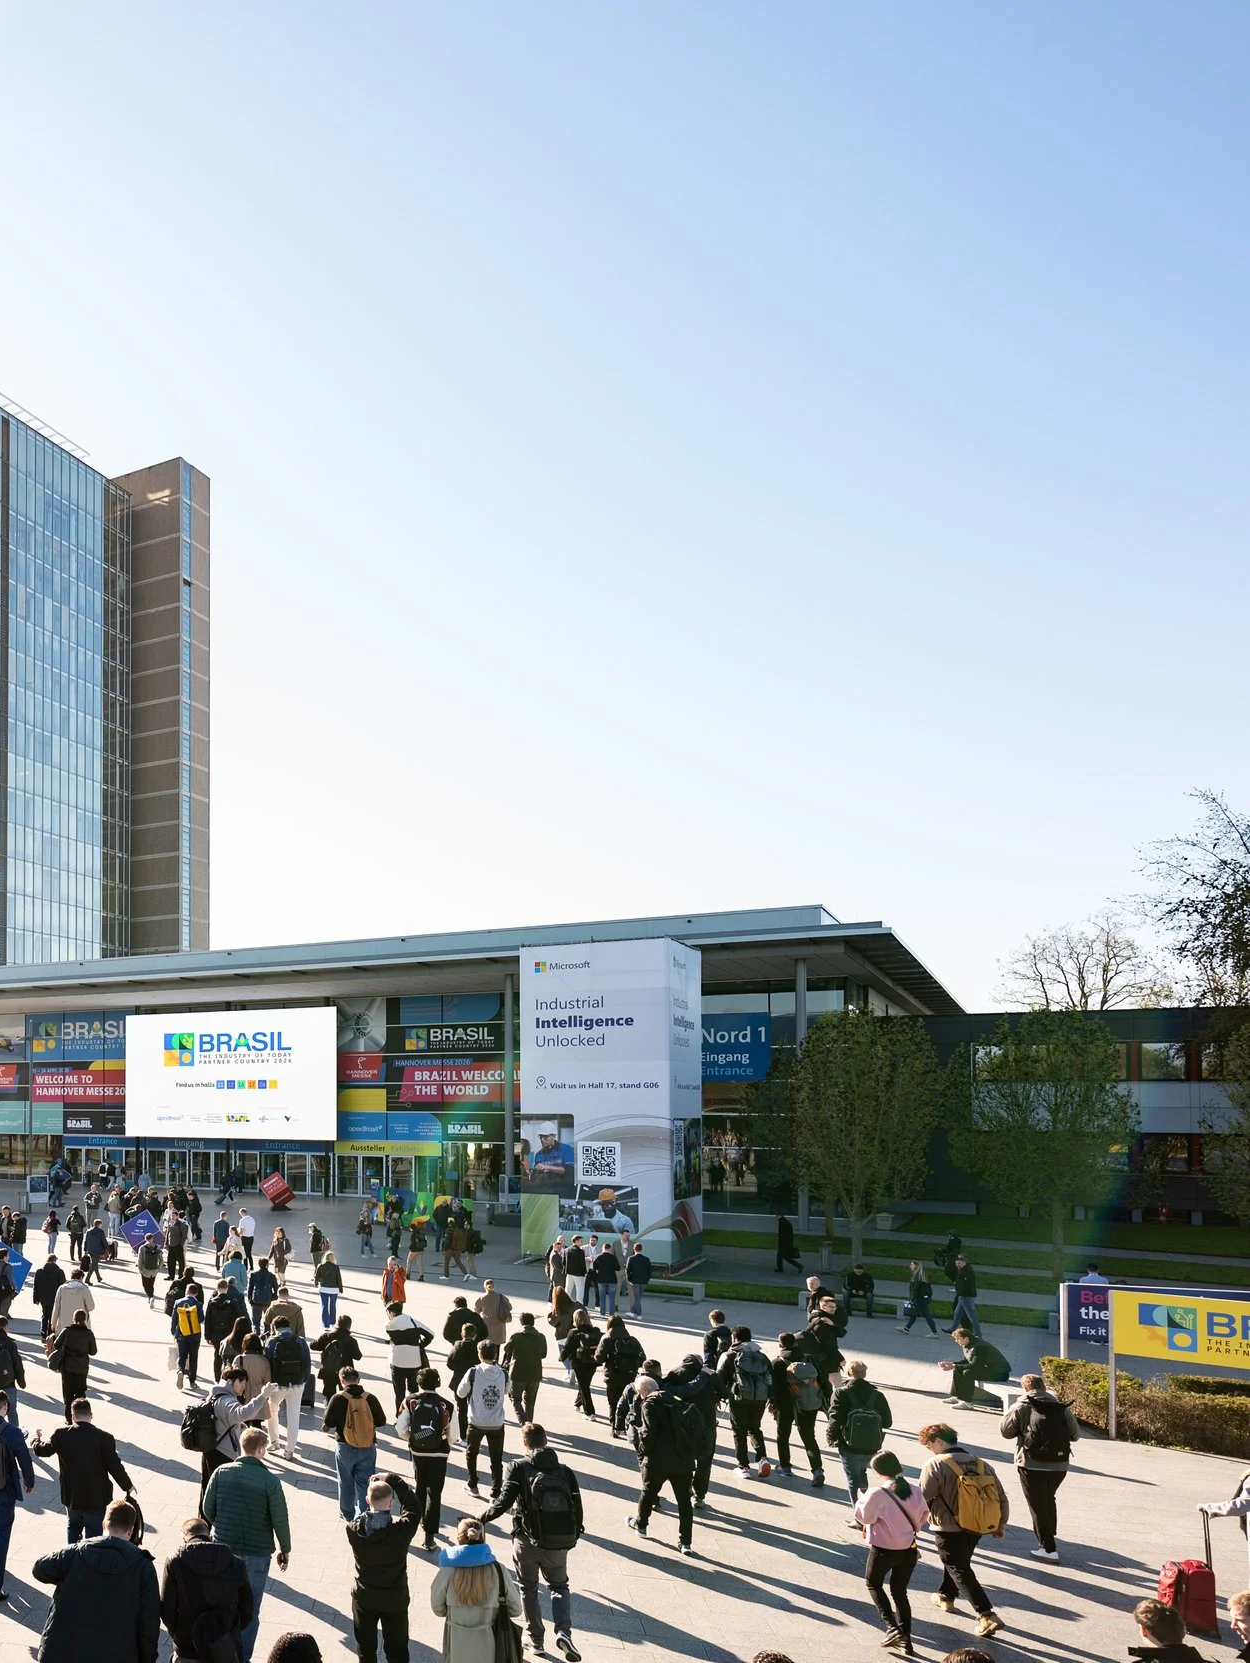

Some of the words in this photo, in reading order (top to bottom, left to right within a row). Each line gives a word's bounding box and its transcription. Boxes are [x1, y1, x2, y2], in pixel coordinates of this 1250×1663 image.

[550, 960, 590, 970] Microsoft
[536, 996, 604, 1010] Industrial
[536, 1015, 634, 1030] Intelligence
[61, 1020, 125, 1039] BRASI
[430, 1027, 495, 1041] BRASIL
[536, 1033, 605, 1047] Unlocked
[702, 1026, 751, 1044] Nord
[758, 1026, 765, 1042] 1
[199, 1032, 292, 1052] BRASIL
[702, 1052, 750, 1064] Eingang
[702, 1066, 753, 1075] Entrance
[35, 1075, 78, 1084] WELCOME
[81, 1075, 93, 1083] TO
[414, 1071, 458, 1081] BRAZIL
[36, 1087, 84, 1096] HANNOVER
[86, 1087, 114, 1096] MESSE
[414, 1085, 437, 1095] THE
[443, 1085, 489, 1095] WORLD
[67, 1119, 92, 1128] BRASIL
[448, 1125, 484, 1134] BRASIL
[89, 1136, 118, 1145] Entrance
[174, 1139, 204, 1149] Eingang
[265, 1141, 300, 1149] Entrance
[1079, 1305, 1109, 1320] the
[1079, 1326, 1096, 1336] Fix
[1098, 1327, 1106, 1336] it
[1207, 1338, 1230, 1347] THE
